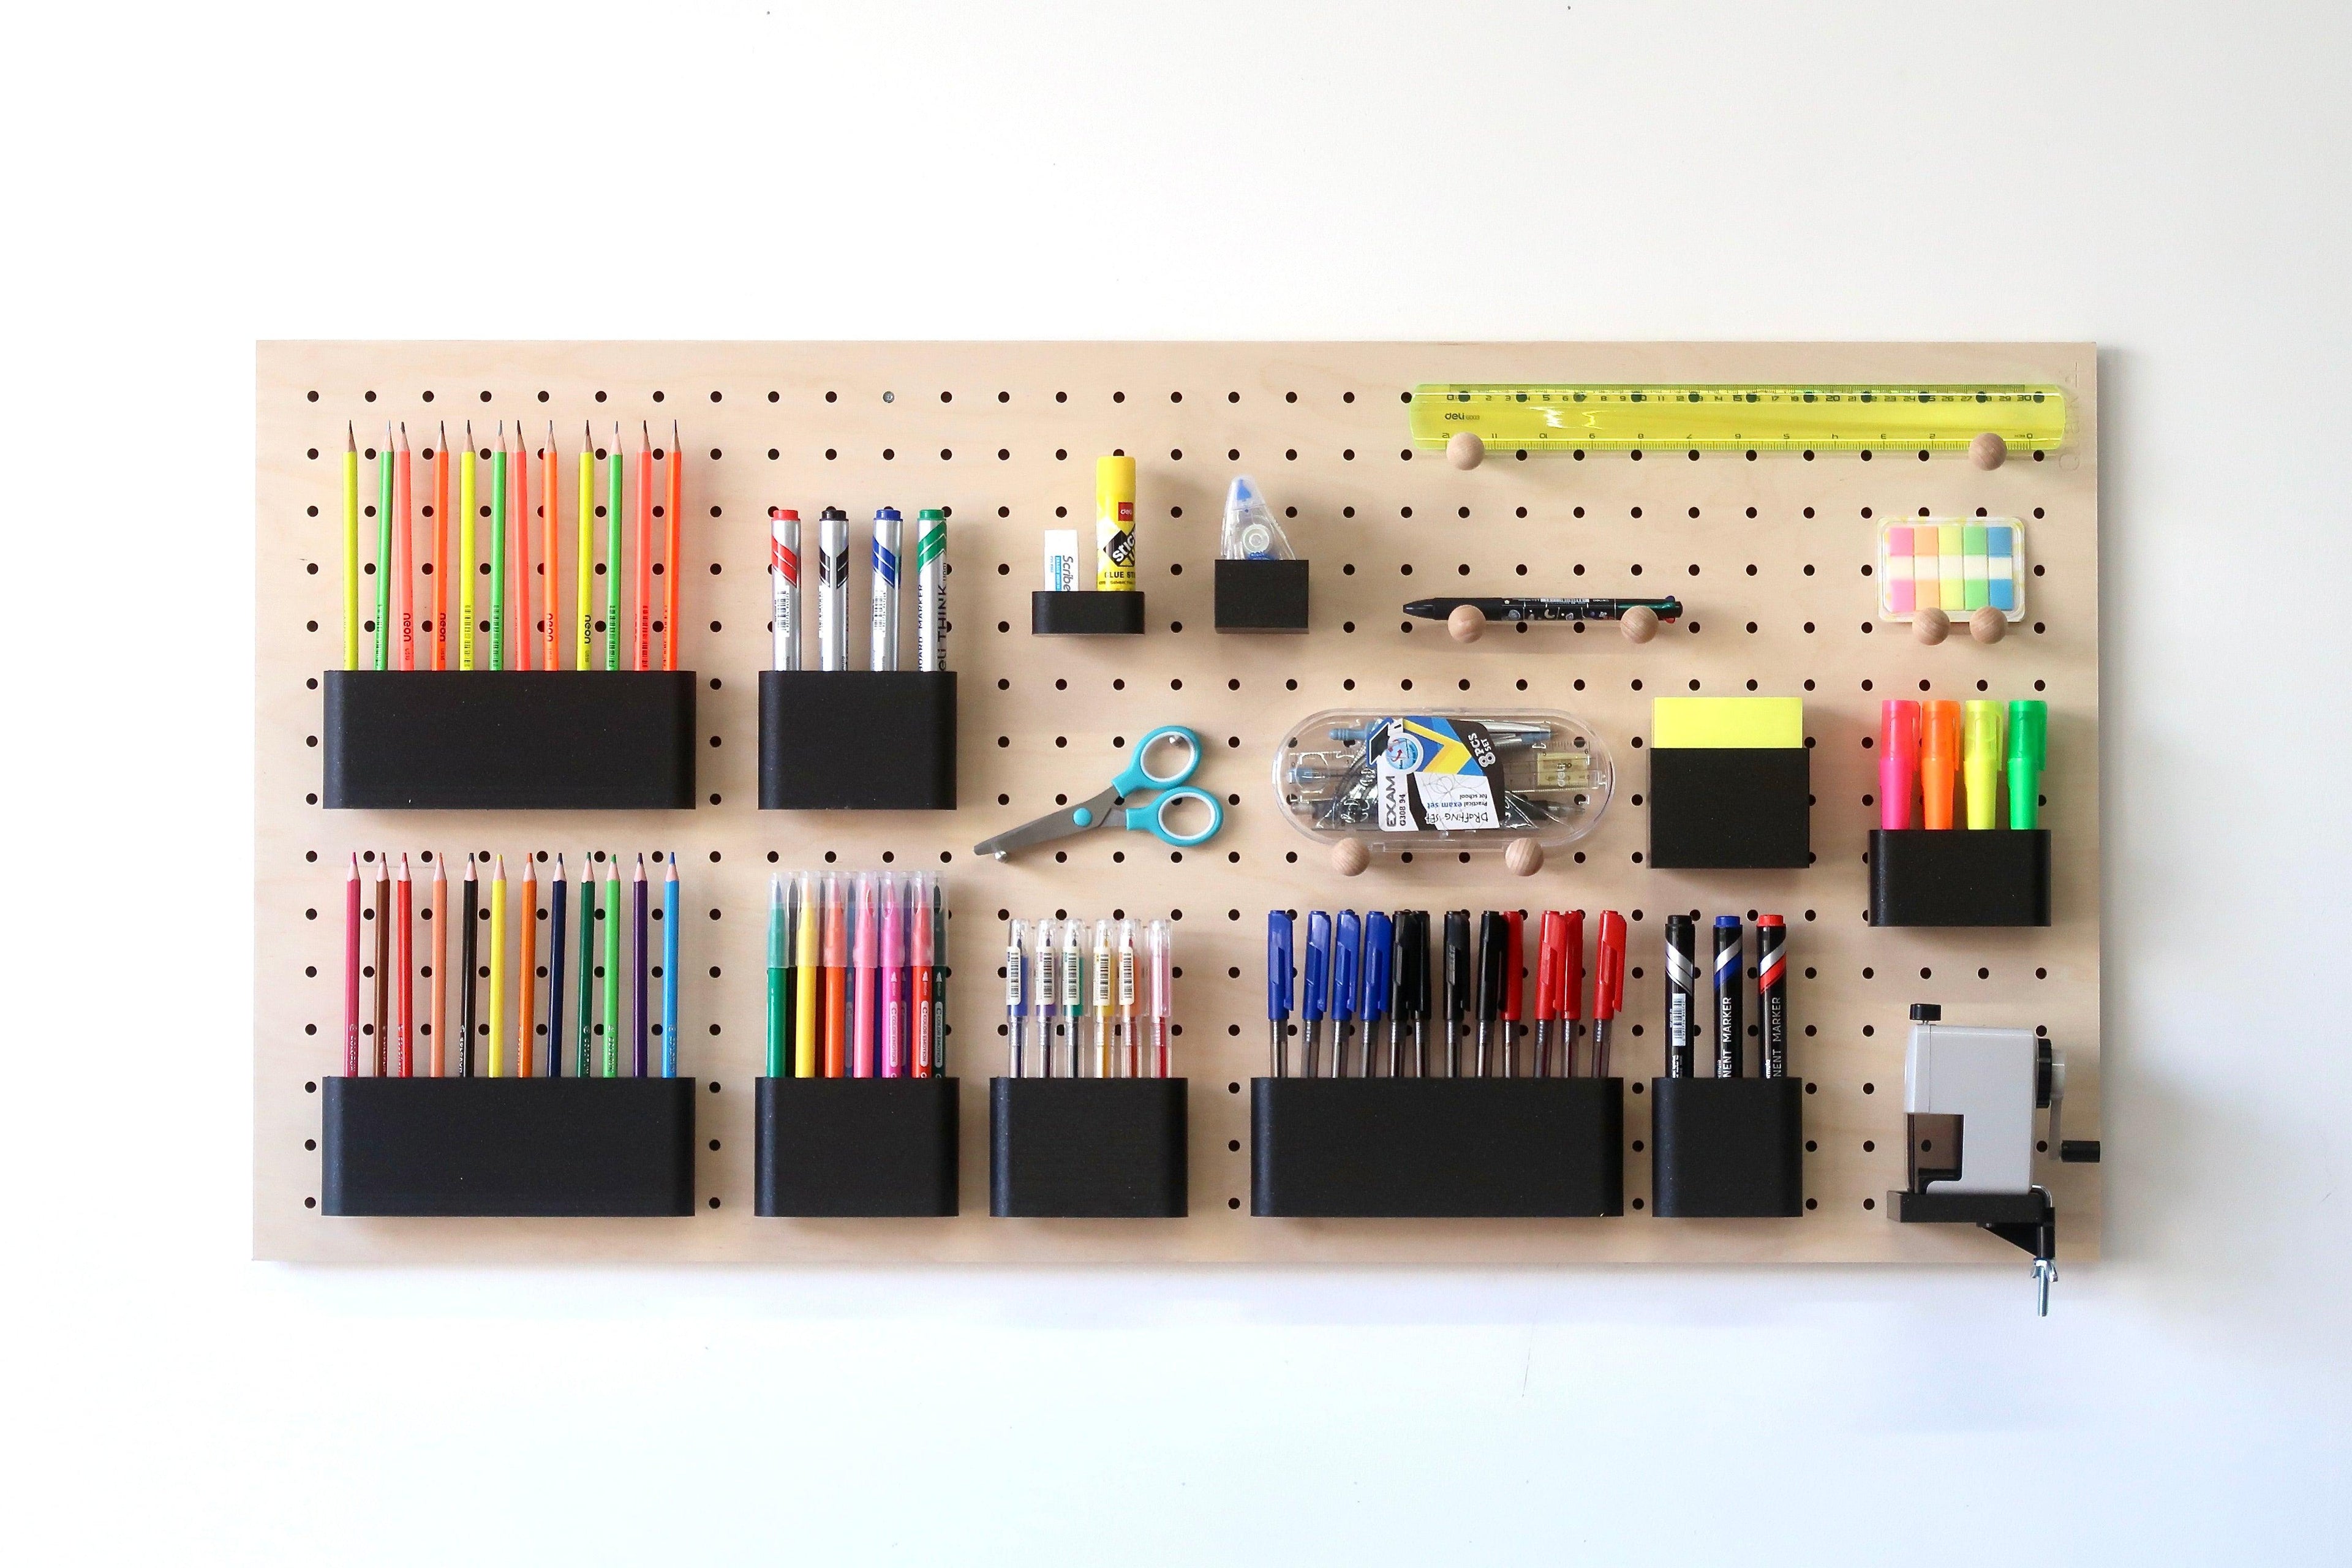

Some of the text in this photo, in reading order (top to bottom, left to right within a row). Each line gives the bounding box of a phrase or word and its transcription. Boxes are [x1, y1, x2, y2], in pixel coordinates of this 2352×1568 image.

[1063, 555, 1074, 592] Scribe
[937, 584, 946, 642] THINK
[937, 649, 946, 671] eli
[1468, 733, 1496, 767] 8 PCS
[1480, 739, 1491, 752] SET
[1385, 776, 1396, 827] EXAM
[1722, 997, 1732, 1042] MARKER
[1772, 997, 1781, 1042] MARKER
